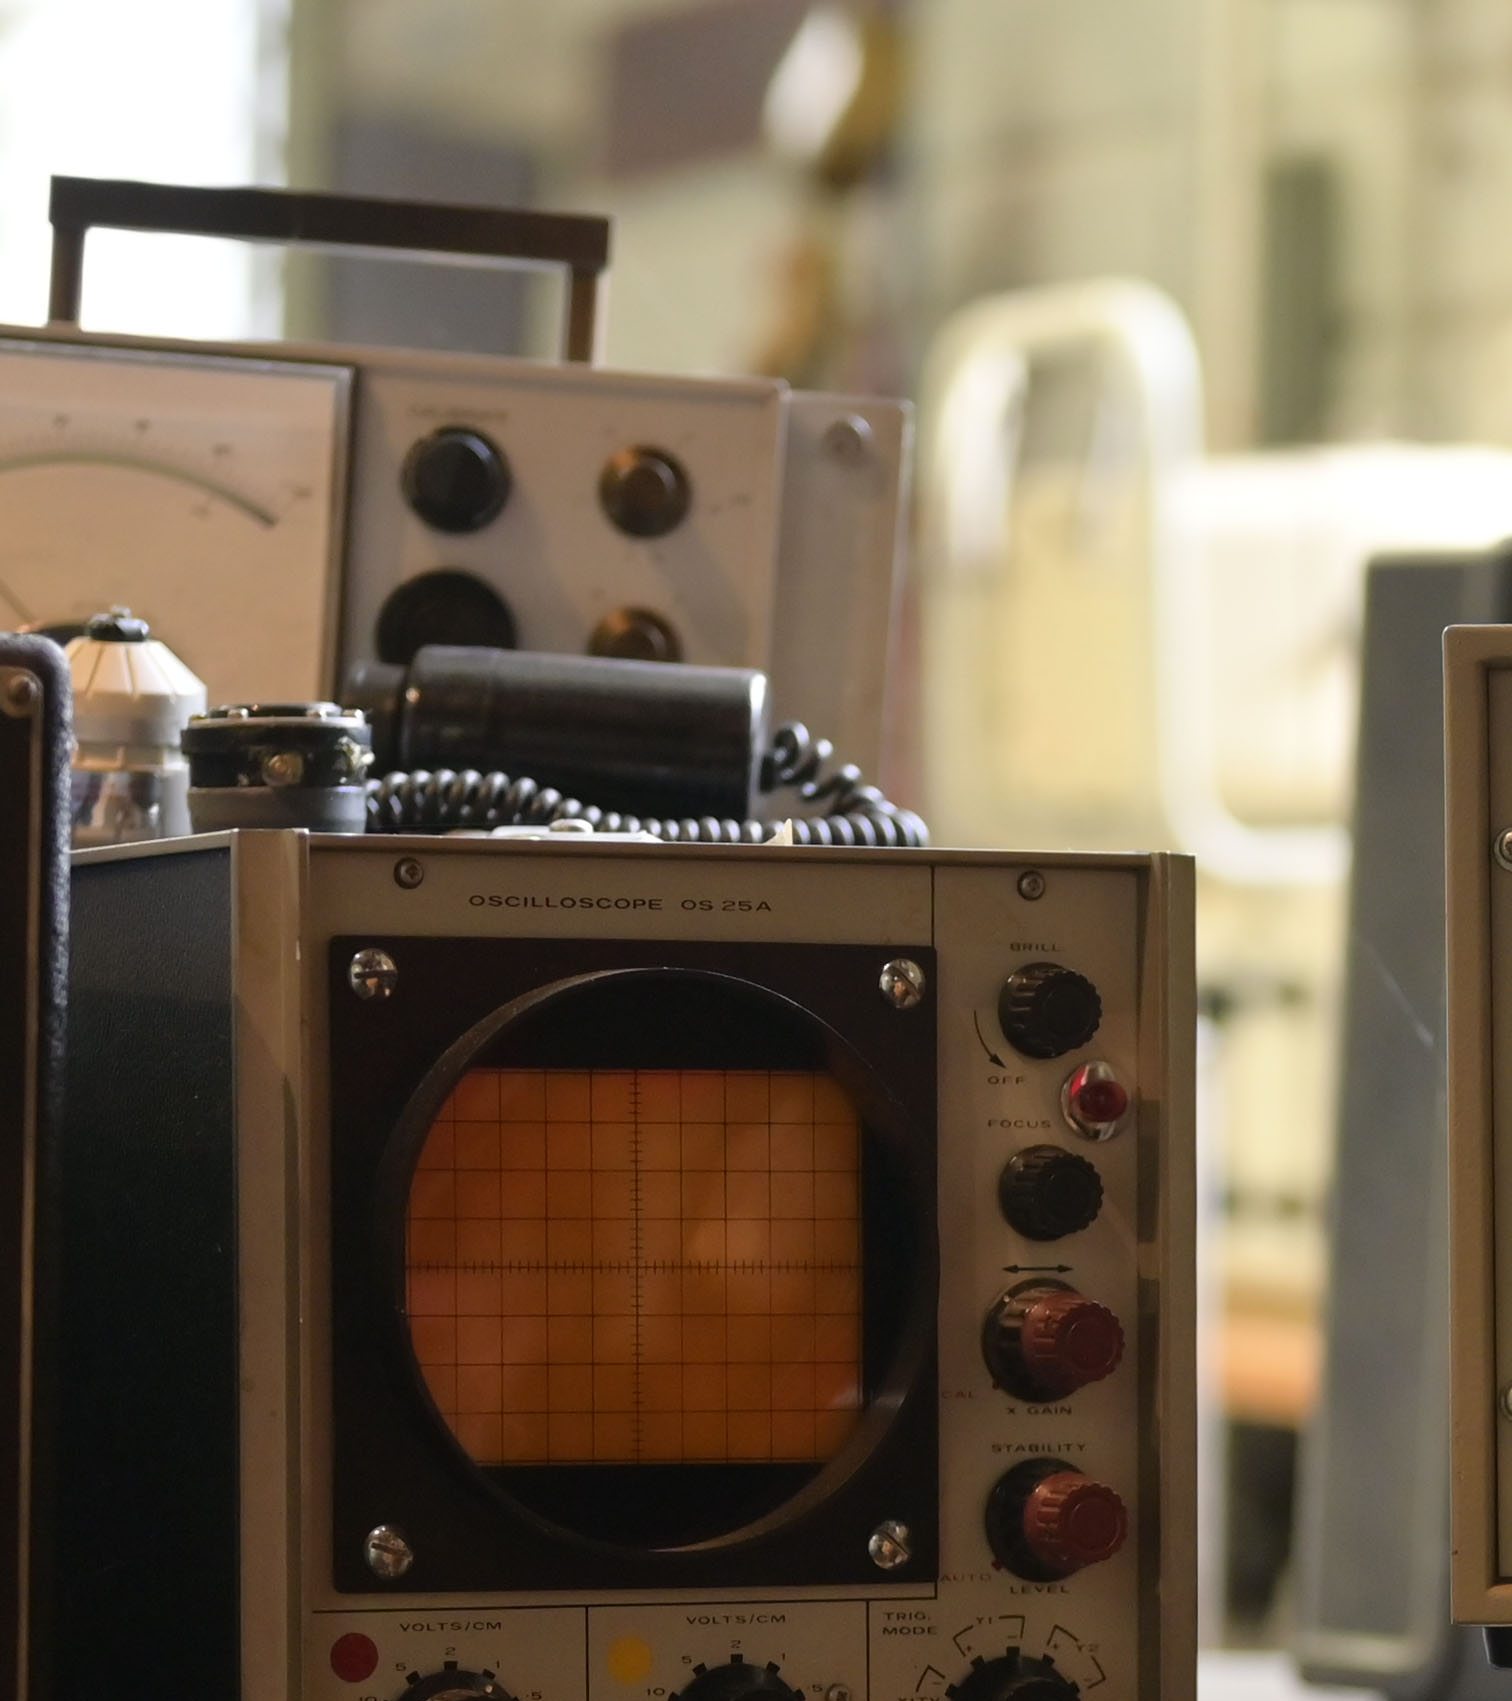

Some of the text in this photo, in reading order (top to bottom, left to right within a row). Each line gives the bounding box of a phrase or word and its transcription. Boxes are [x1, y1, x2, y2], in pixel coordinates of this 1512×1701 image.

[468, 895, 773, 910] OSCILLOSCOPE OS 25A
[987, 1075, 1026, 1085] OFF
[987, 1119, 1051, 1128] FOCUS
[1027, 1406, 1072, 1415] GAIN
[991, 1443, 1086, 1453] STABILITY
[940, 1573, 991, 1582] AUTO
[1009, 1585, 1069, 1595] LEVEL
[686, 1613, 787, 1625] VOLTS/CM
[399, 1621, 503, 1631] VOLTS/CM
[882, 1626, 936, 1635] MODE
[730, 1639, 742, 1650] 2
[445, 1647, 457, 1657] 2
[681, 1655, 693, 1665] 5
[395, 1662, 407, 1672] 5
[648, 1687, 666, 1697] 10
